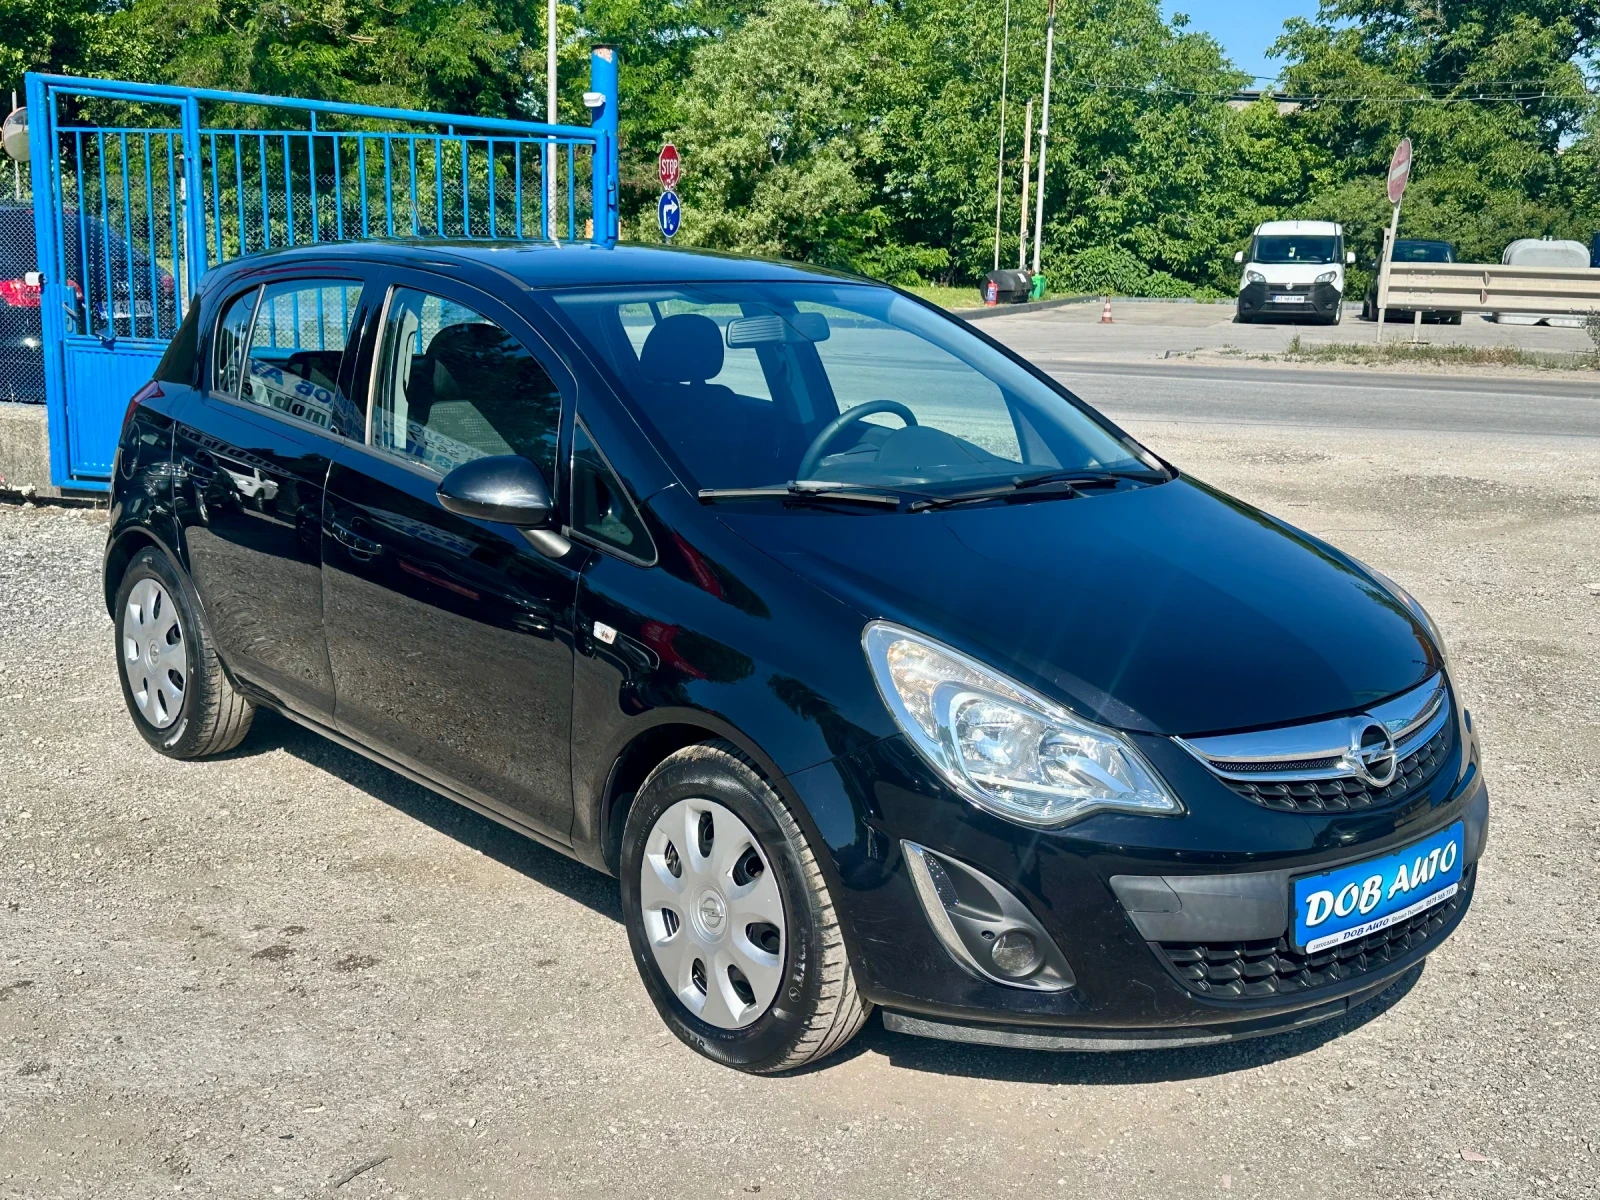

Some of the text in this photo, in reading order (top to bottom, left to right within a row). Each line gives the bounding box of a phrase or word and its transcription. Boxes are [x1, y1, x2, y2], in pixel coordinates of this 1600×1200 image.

[661, 159, 678, 175] STOP
[1305, 839, 1457, 927] DOB AUTO
[1343, 926, 1365, 940] DOB
[1366, 918, 1389, 932] AUTO
